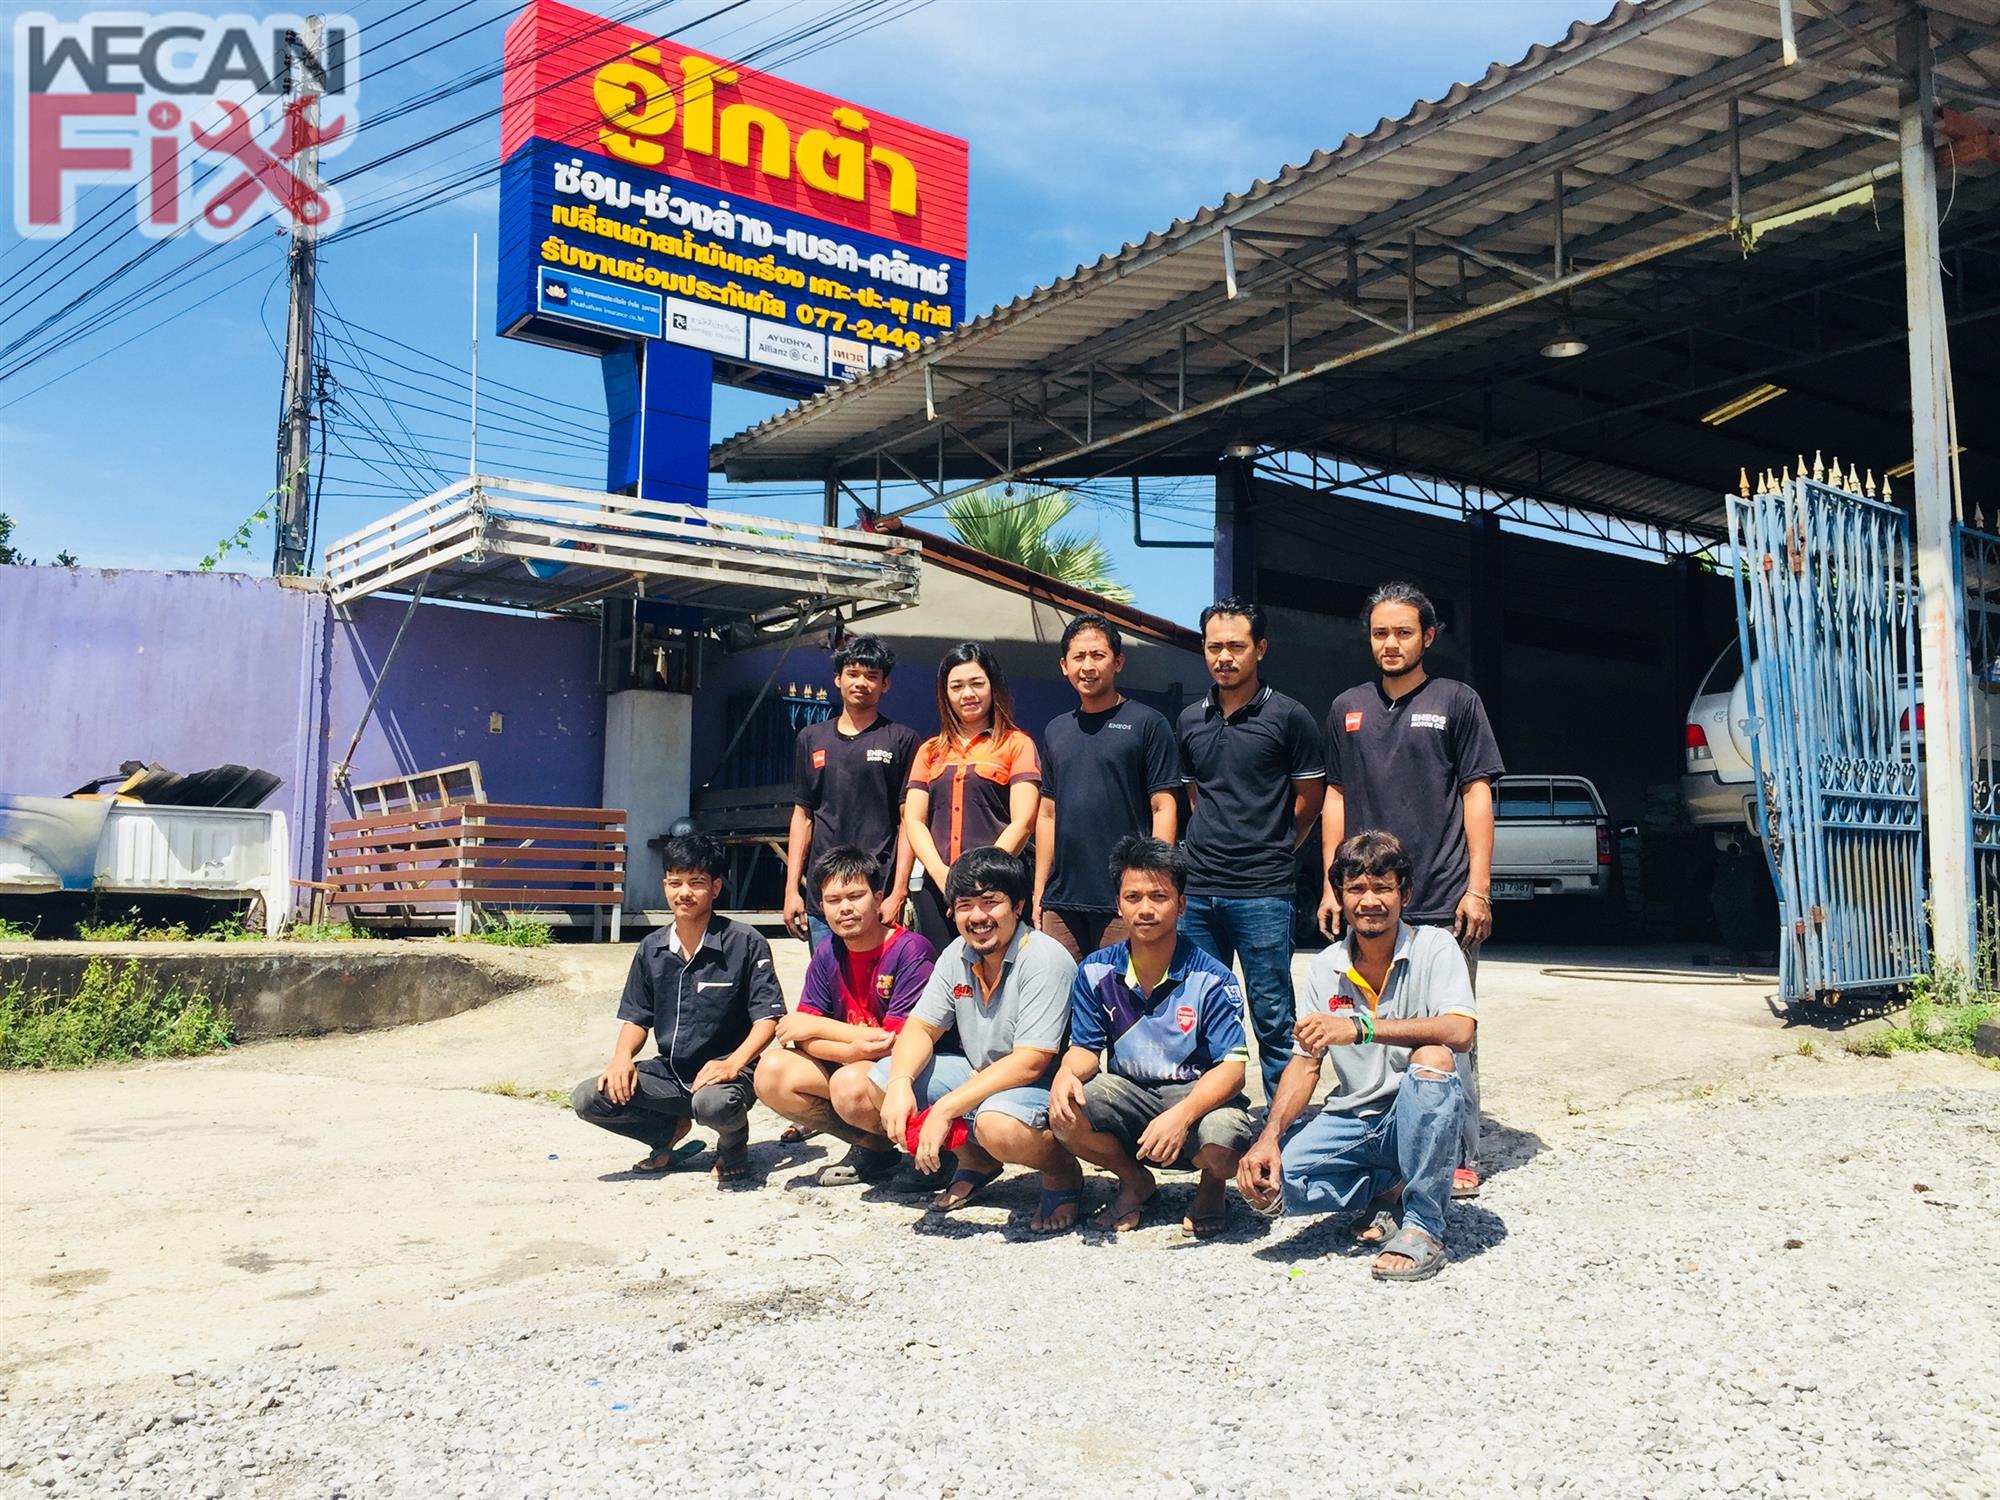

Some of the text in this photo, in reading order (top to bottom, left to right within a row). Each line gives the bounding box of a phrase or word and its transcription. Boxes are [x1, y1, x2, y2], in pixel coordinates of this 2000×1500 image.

[541, 236, 786, 319] รับงานซ่อมประกันภัย
[913, 300, 951, 328] ทำสี
[758, 342, 788, 357] Allianz
[767, 334, 813, 350] AYUDHYA
[1410, 721, 1434, 729] MOTOR
[1411, 713, 1447, 726] ENEOS
[866, 749, 894, 760] ENEOS
